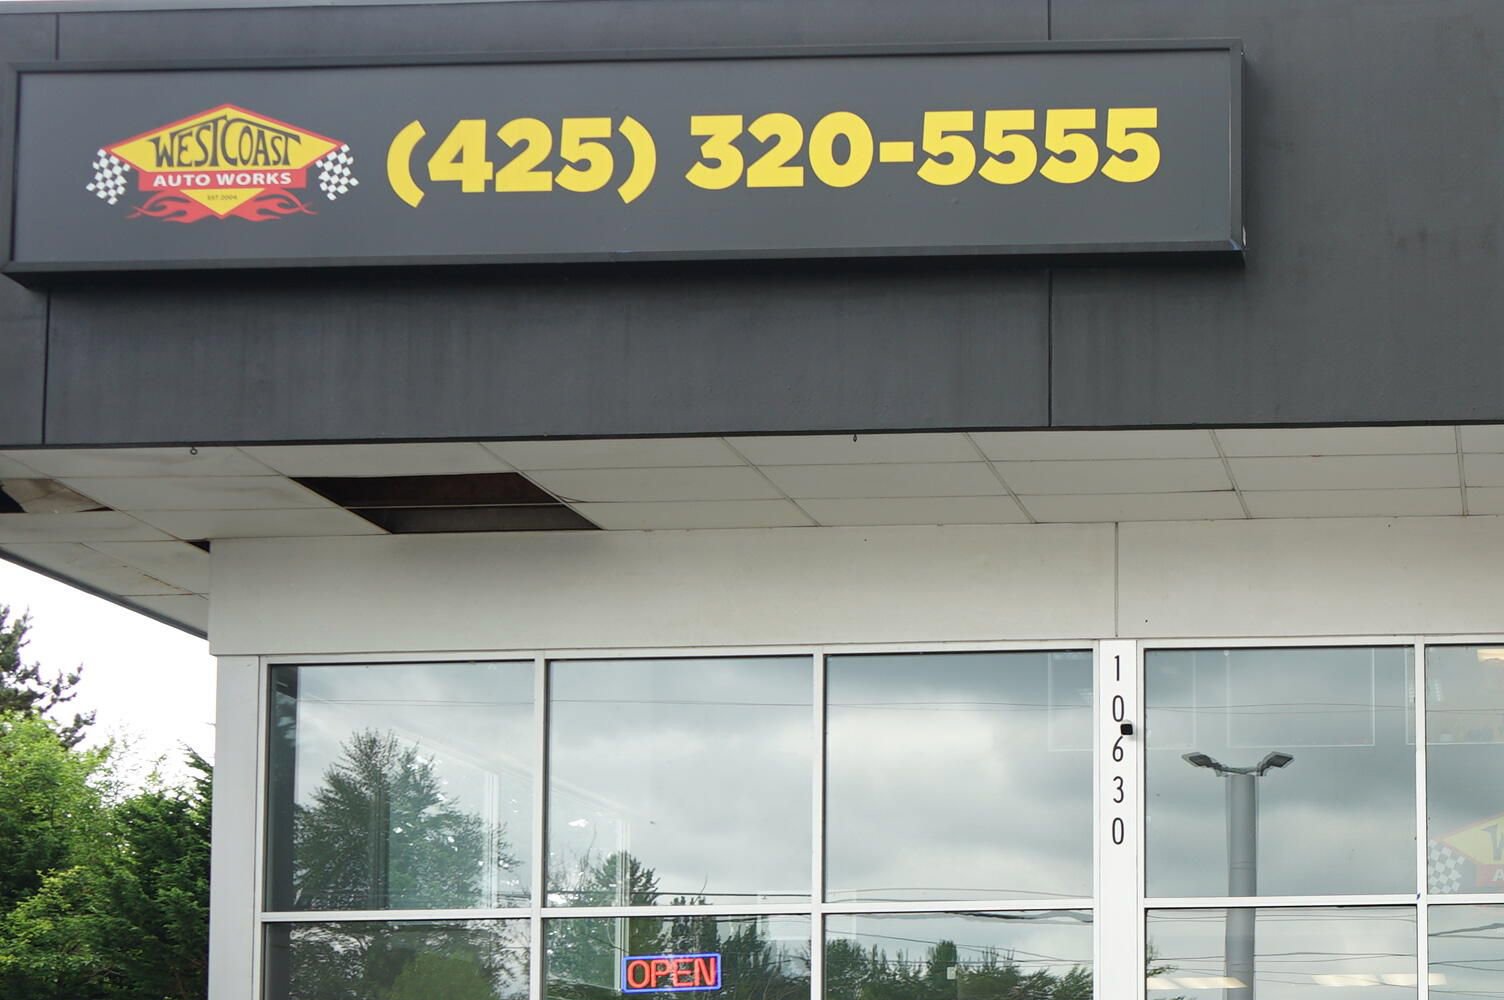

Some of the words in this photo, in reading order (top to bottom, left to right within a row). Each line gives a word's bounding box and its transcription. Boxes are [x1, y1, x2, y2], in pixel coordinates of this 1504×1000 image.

[386, 115, 657, 209] (425)
[685, 107, 1161, 190] 320-5555
[153, 173, 212, 187] AUTO
[216, 172, 293, 186] WORKS
[627, 957, 716, 989] OPEN
